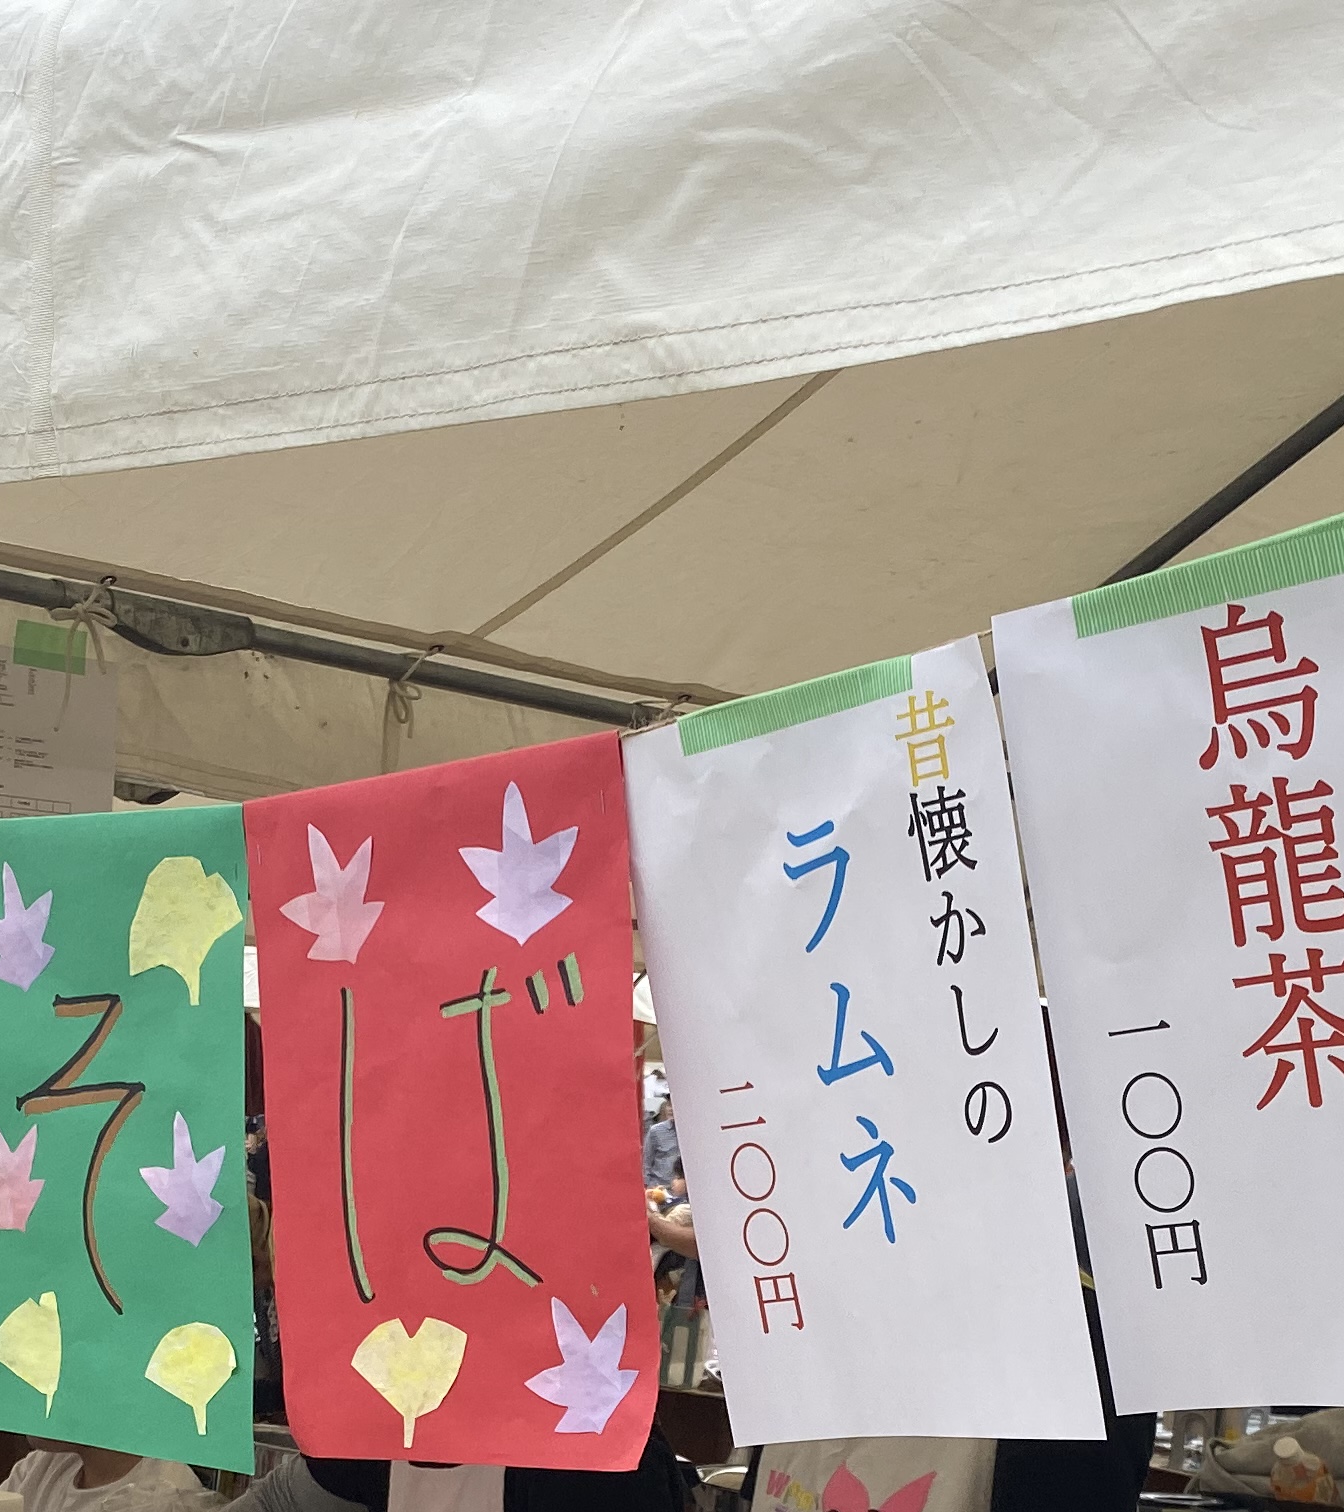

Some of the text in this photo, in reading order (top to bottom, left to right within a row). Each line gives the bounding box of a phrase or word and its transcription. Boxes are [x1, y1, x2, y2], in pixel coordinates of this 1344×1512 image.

[782, 820, 918, 1245] ラムネ
[895, 690, 1014, 1144] 昔懐かしの
[15, 994, 147, 1316] そ
[341, 952, 585, 1304] ば
[718, 1080, 805, 1335] 二〇〇円
[1107, 1018, 1209, 1290] 一〇〇円
